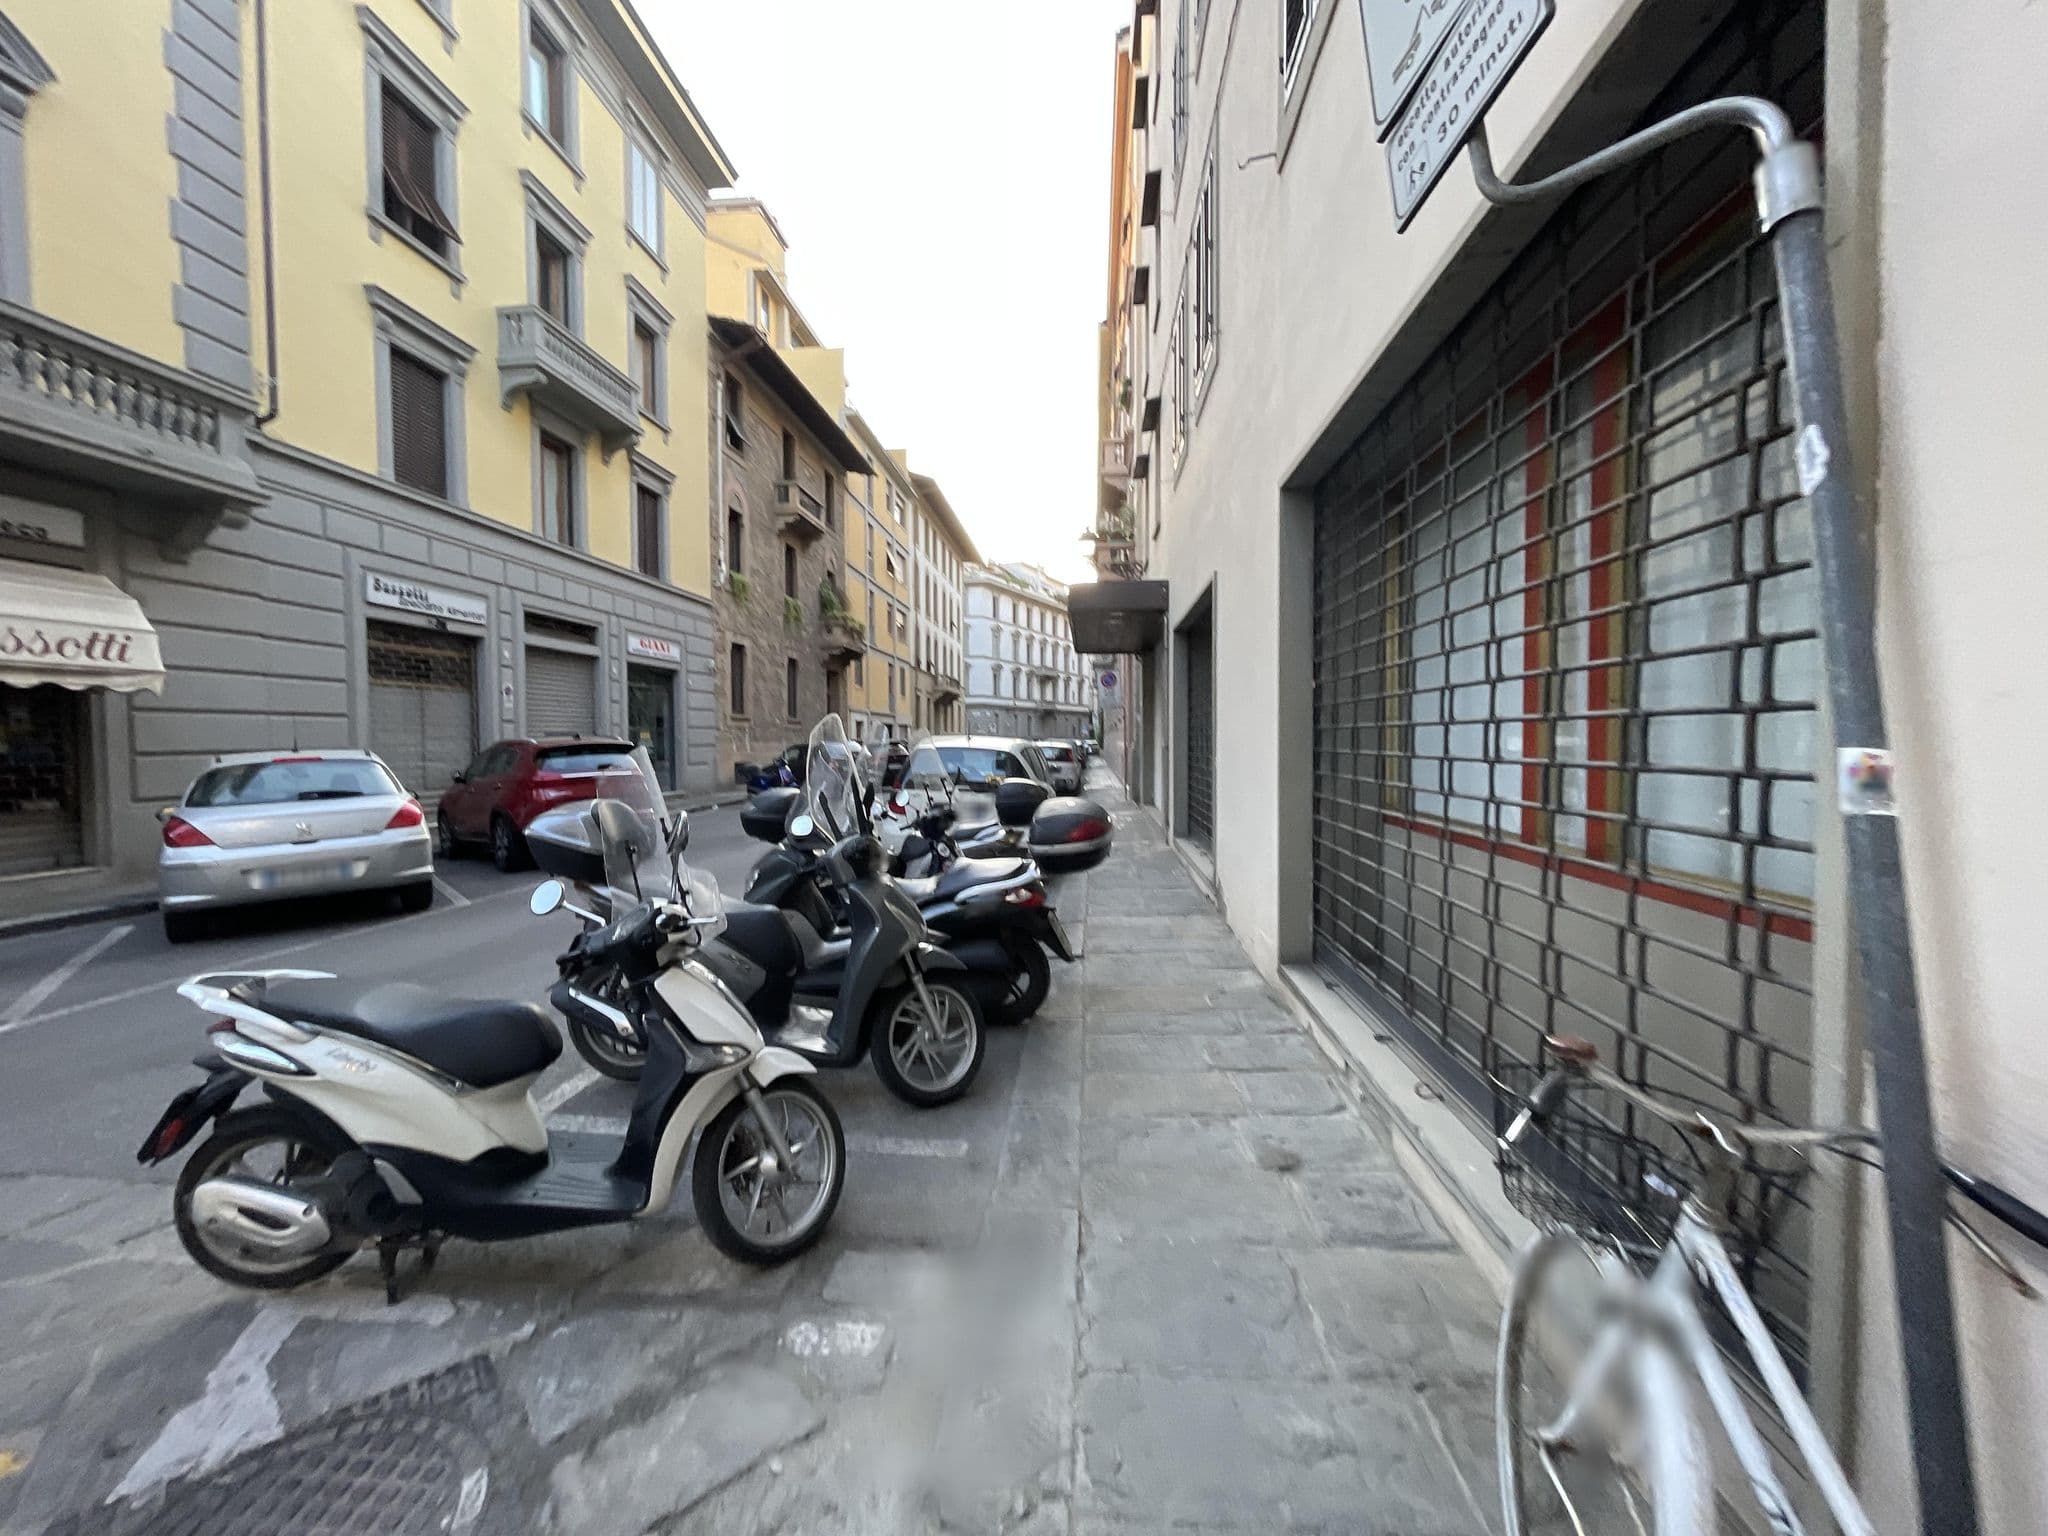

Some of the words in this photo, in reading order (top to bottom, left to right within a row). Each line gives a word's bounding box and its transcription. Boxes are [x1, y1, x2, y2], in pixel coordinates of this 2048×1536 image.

[1398, 141, 1415, 172] con
[1421, 0, 1504, 133] contrassegno
[1398, 79, 1437, 148] eccetto
[1437, 104, 1459, 143] 30
[1464, 11, 1523, 102] minuti
